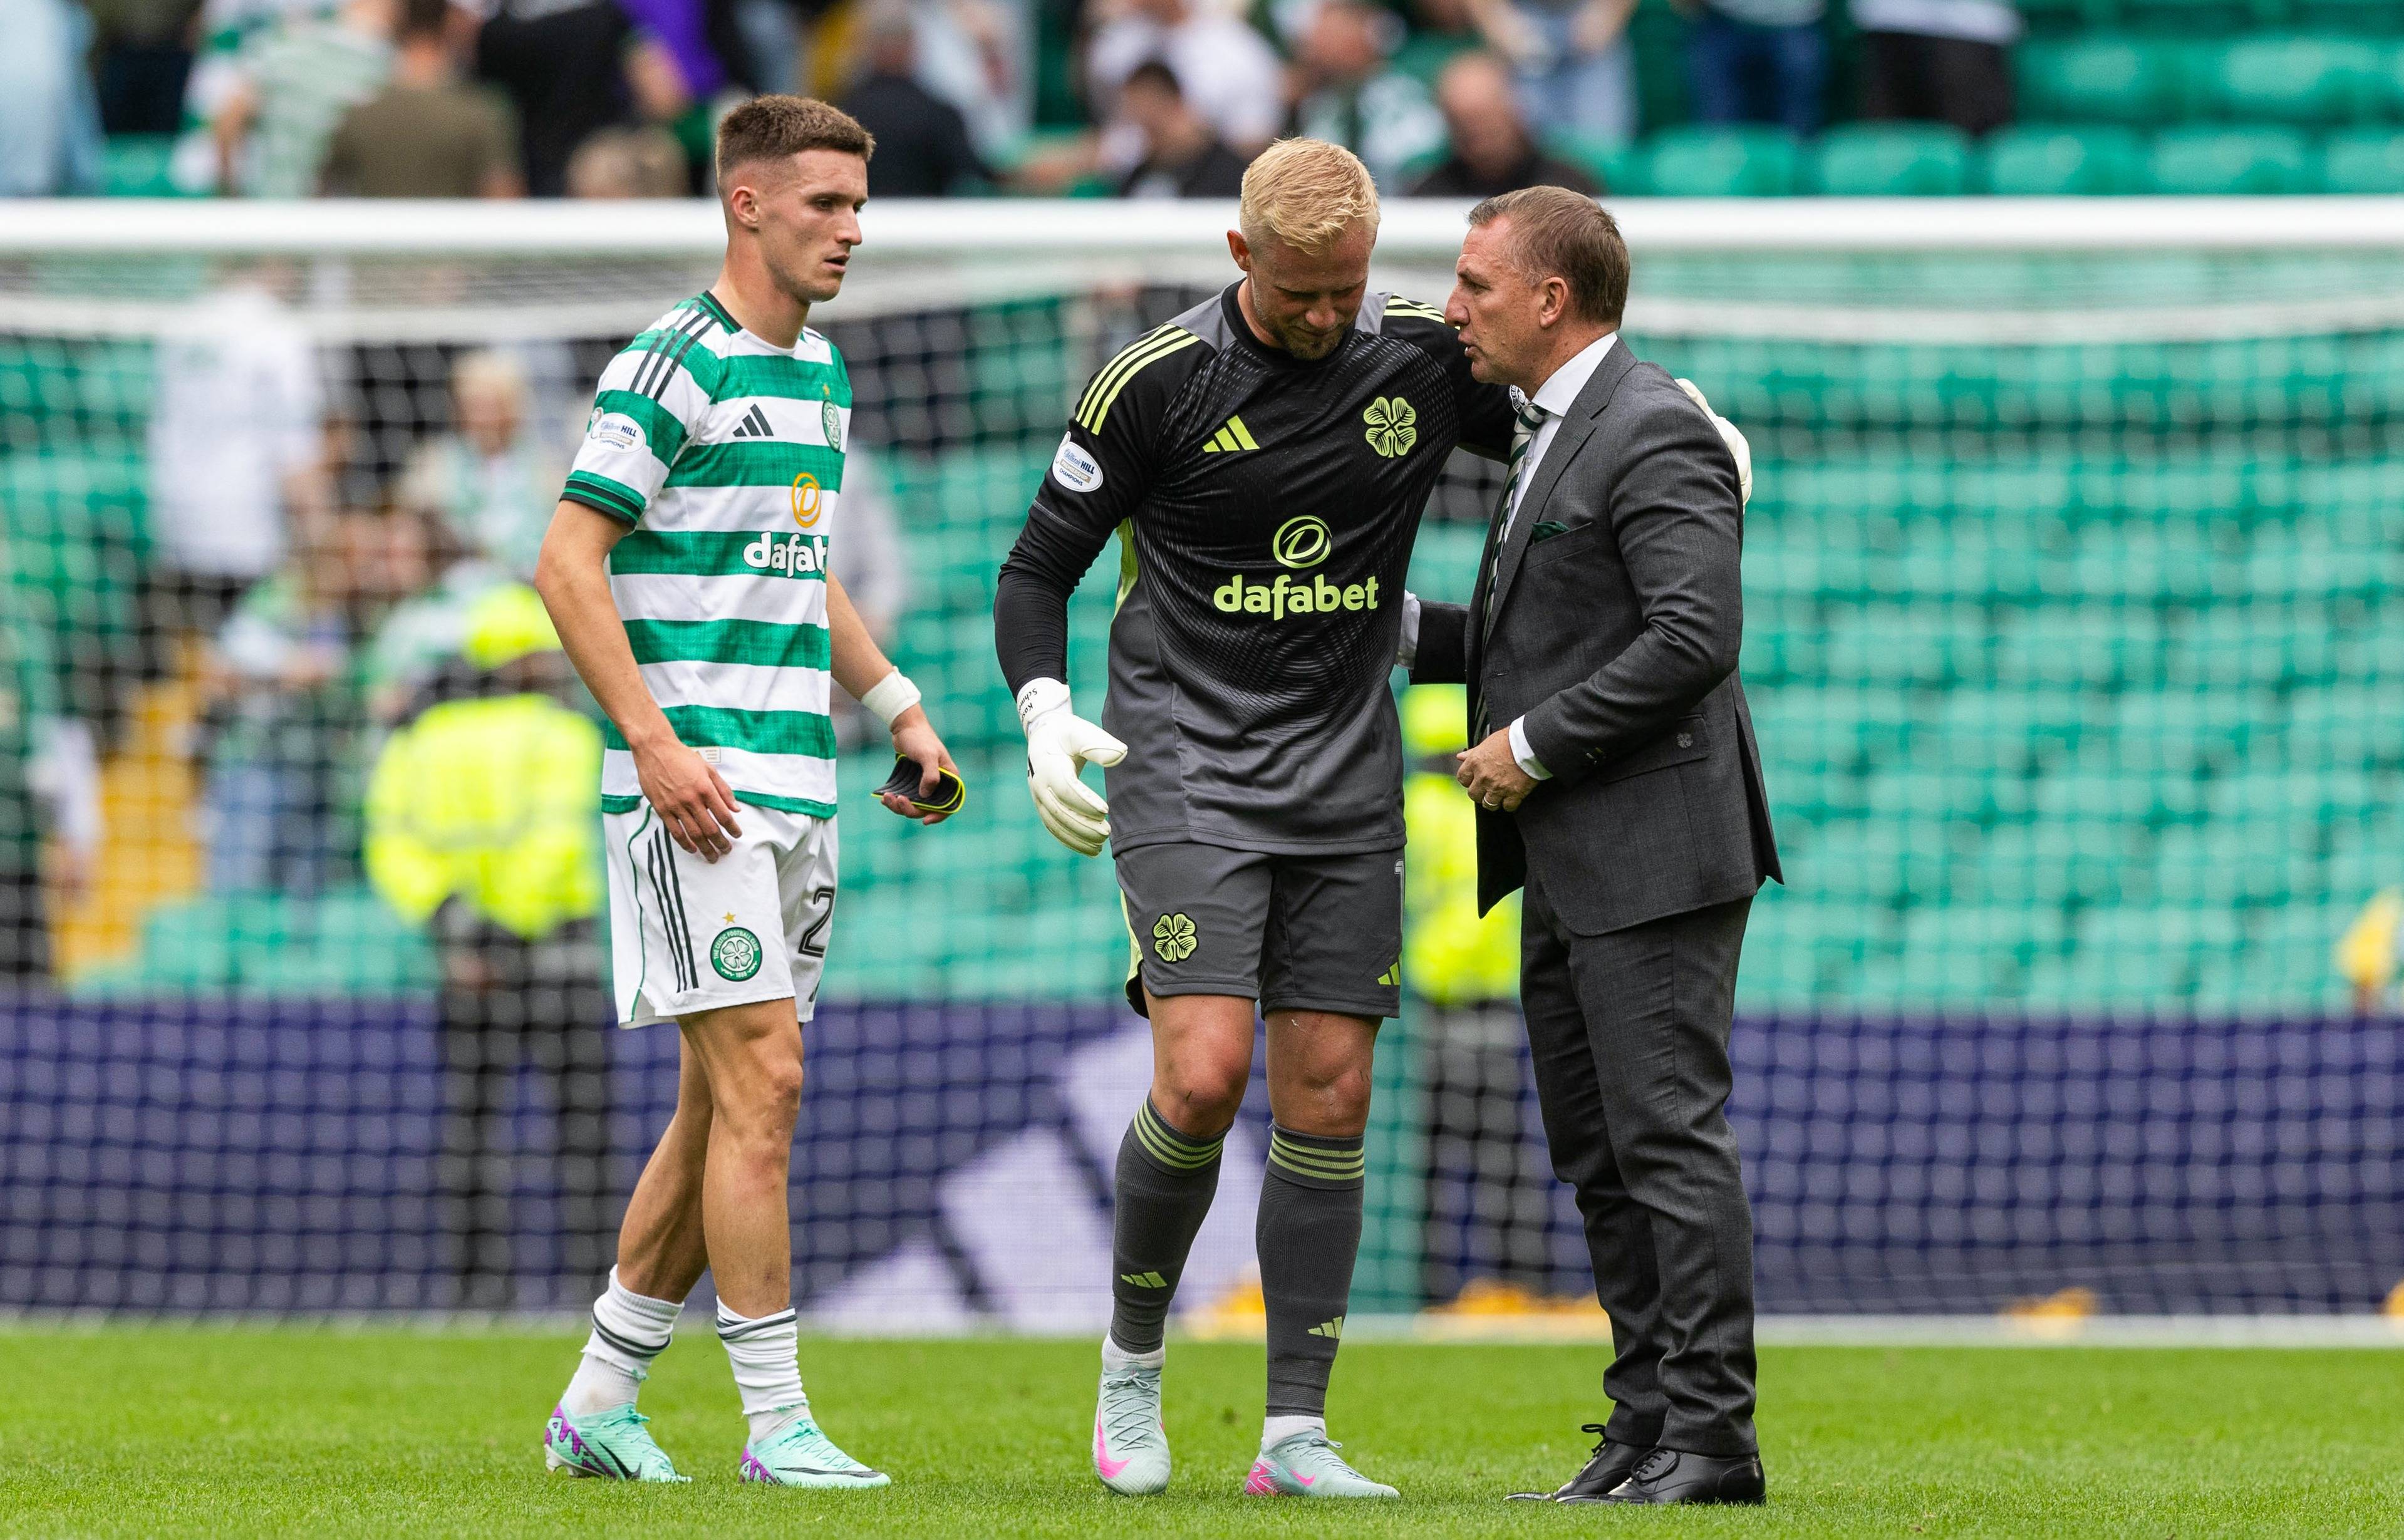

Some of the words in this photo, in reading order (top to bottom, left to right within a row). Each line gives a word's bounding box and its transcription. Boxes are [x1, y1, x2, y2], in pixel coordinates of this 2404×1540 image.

[621, 425, 637, 437] HILL
[1080, 460, 1095, 475] HILL
[1060, 468, 1083, 486] CHAMPIONS
[743, 530, 827, 579] dafab
[1213, 574, 1379, 621] dafabet
[797, 886, 835, 959] 2
[714, 934, 727, 949] CELTIC
